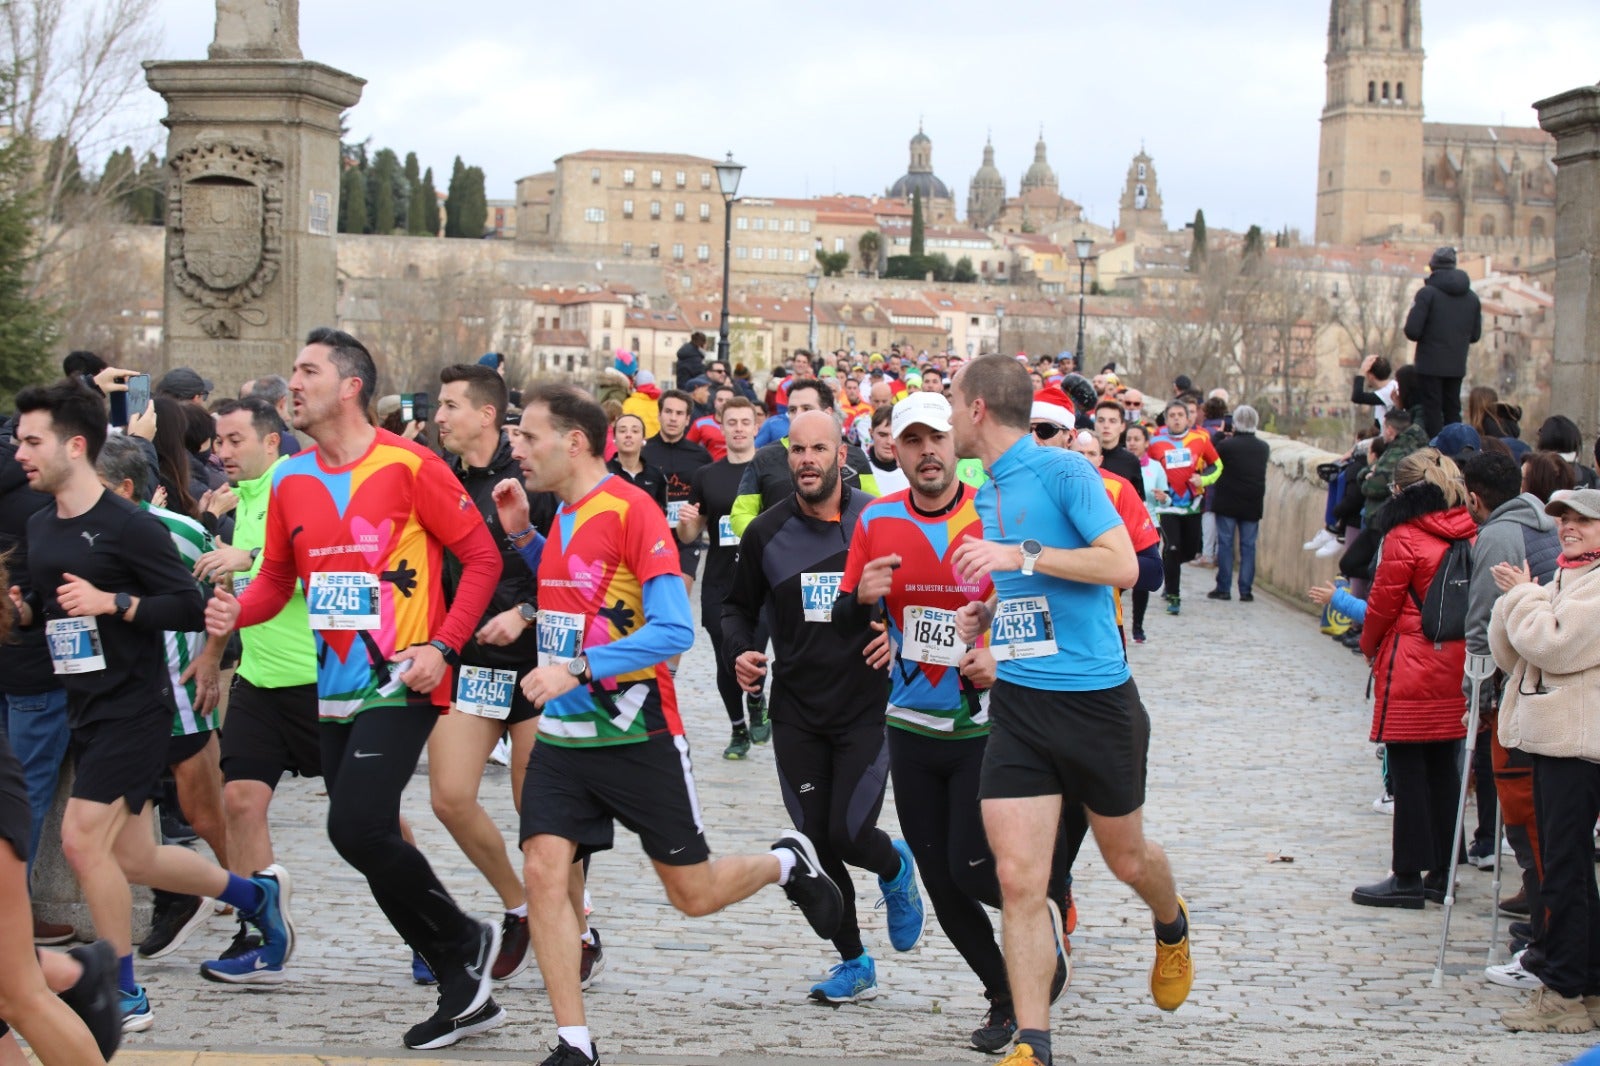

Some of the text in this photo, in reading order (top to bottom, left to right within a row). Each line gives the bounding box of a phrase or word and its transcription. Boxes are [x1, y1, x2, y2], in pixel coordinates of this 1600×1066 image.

[328, 575, 371, 585] SETEL
[905, 584, 980, 593] SAN SILVESTRE SALMANTINA
[316, 587, 360, 610] 2246
[1003, 600, 1042, 613] SETEL
[545, 614, 577, 627] SETEL
[924, 609, 956, 623] SET
[56, 620, 89, 631] SETEL
[995, 613, 1037, 640] 2633
[914, 620, 956, 647] 1843
[466, 679, 505, 703] 3494
